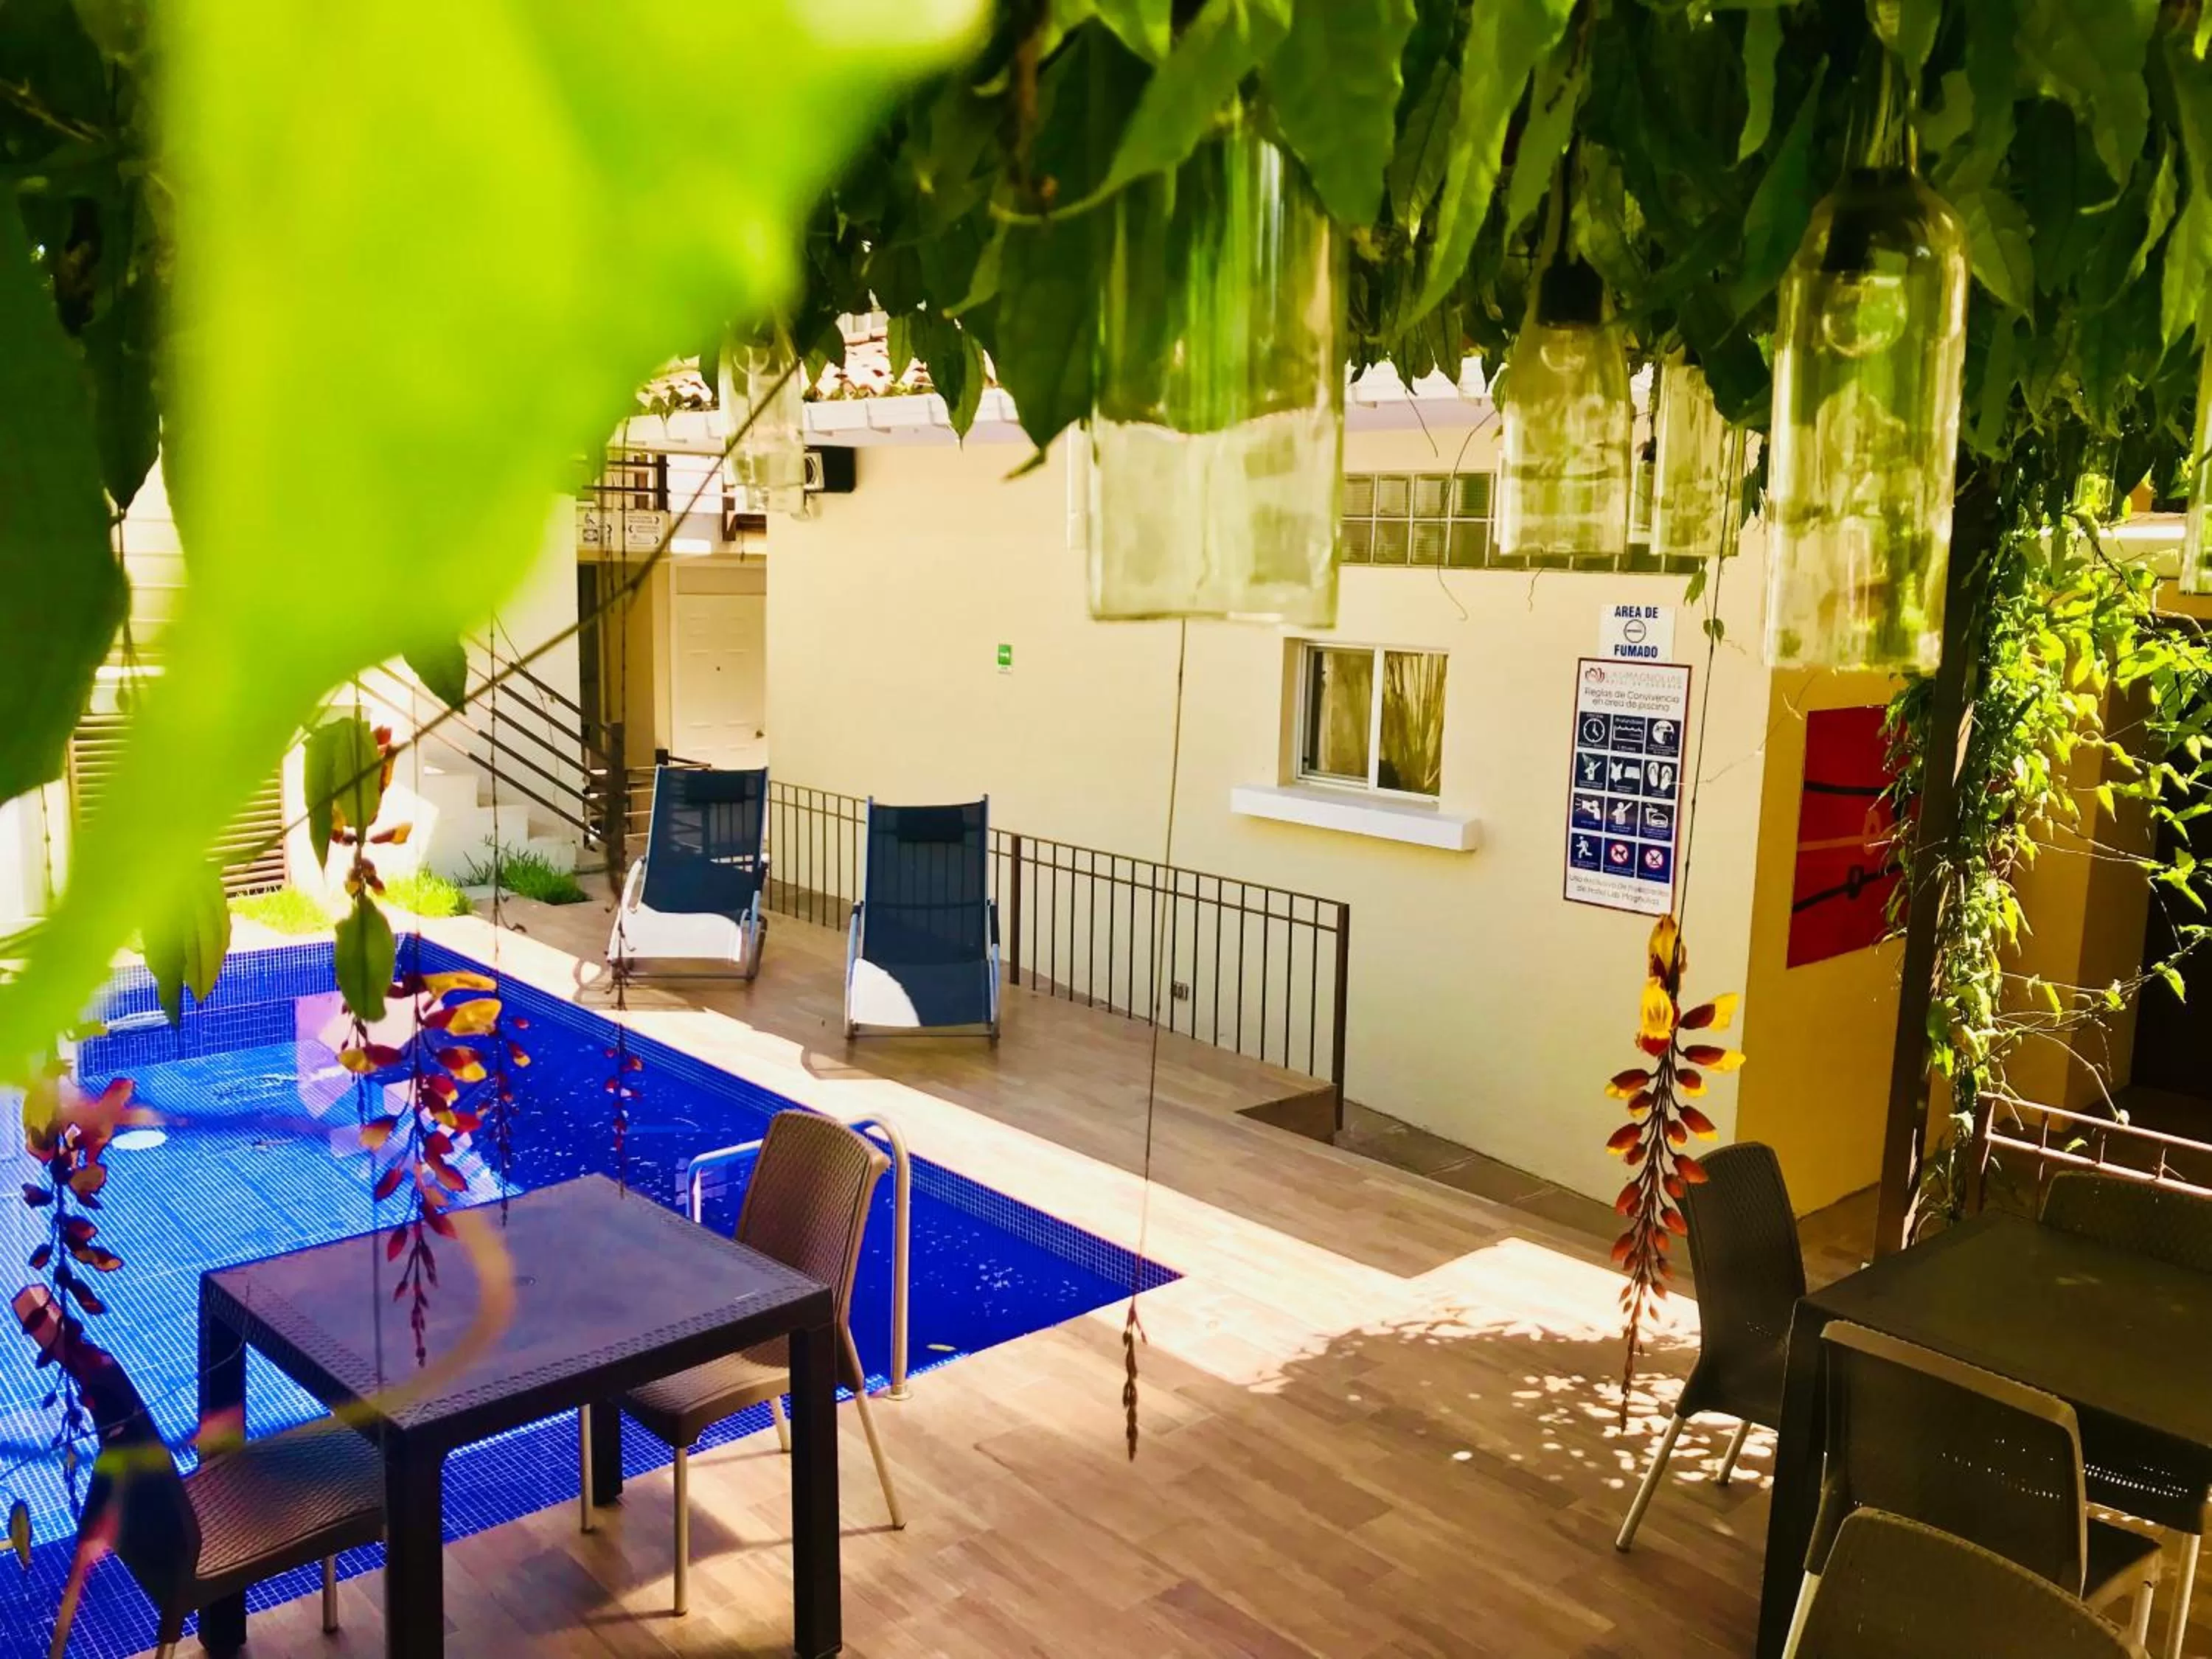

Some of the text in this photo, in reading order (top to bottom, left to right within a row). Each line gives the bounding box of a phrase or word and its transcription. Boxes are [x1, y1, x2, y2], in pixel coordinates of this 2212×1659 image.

[1615, 605, 1658, 619] AREA DE
[1614, 644, 1658, 658] FUMADO
[1585, 686, 1680, 704] Reglas de Convivencia
[1626, 700, 1637, 709] de
[1638, 703, 1670, 712] piscina
